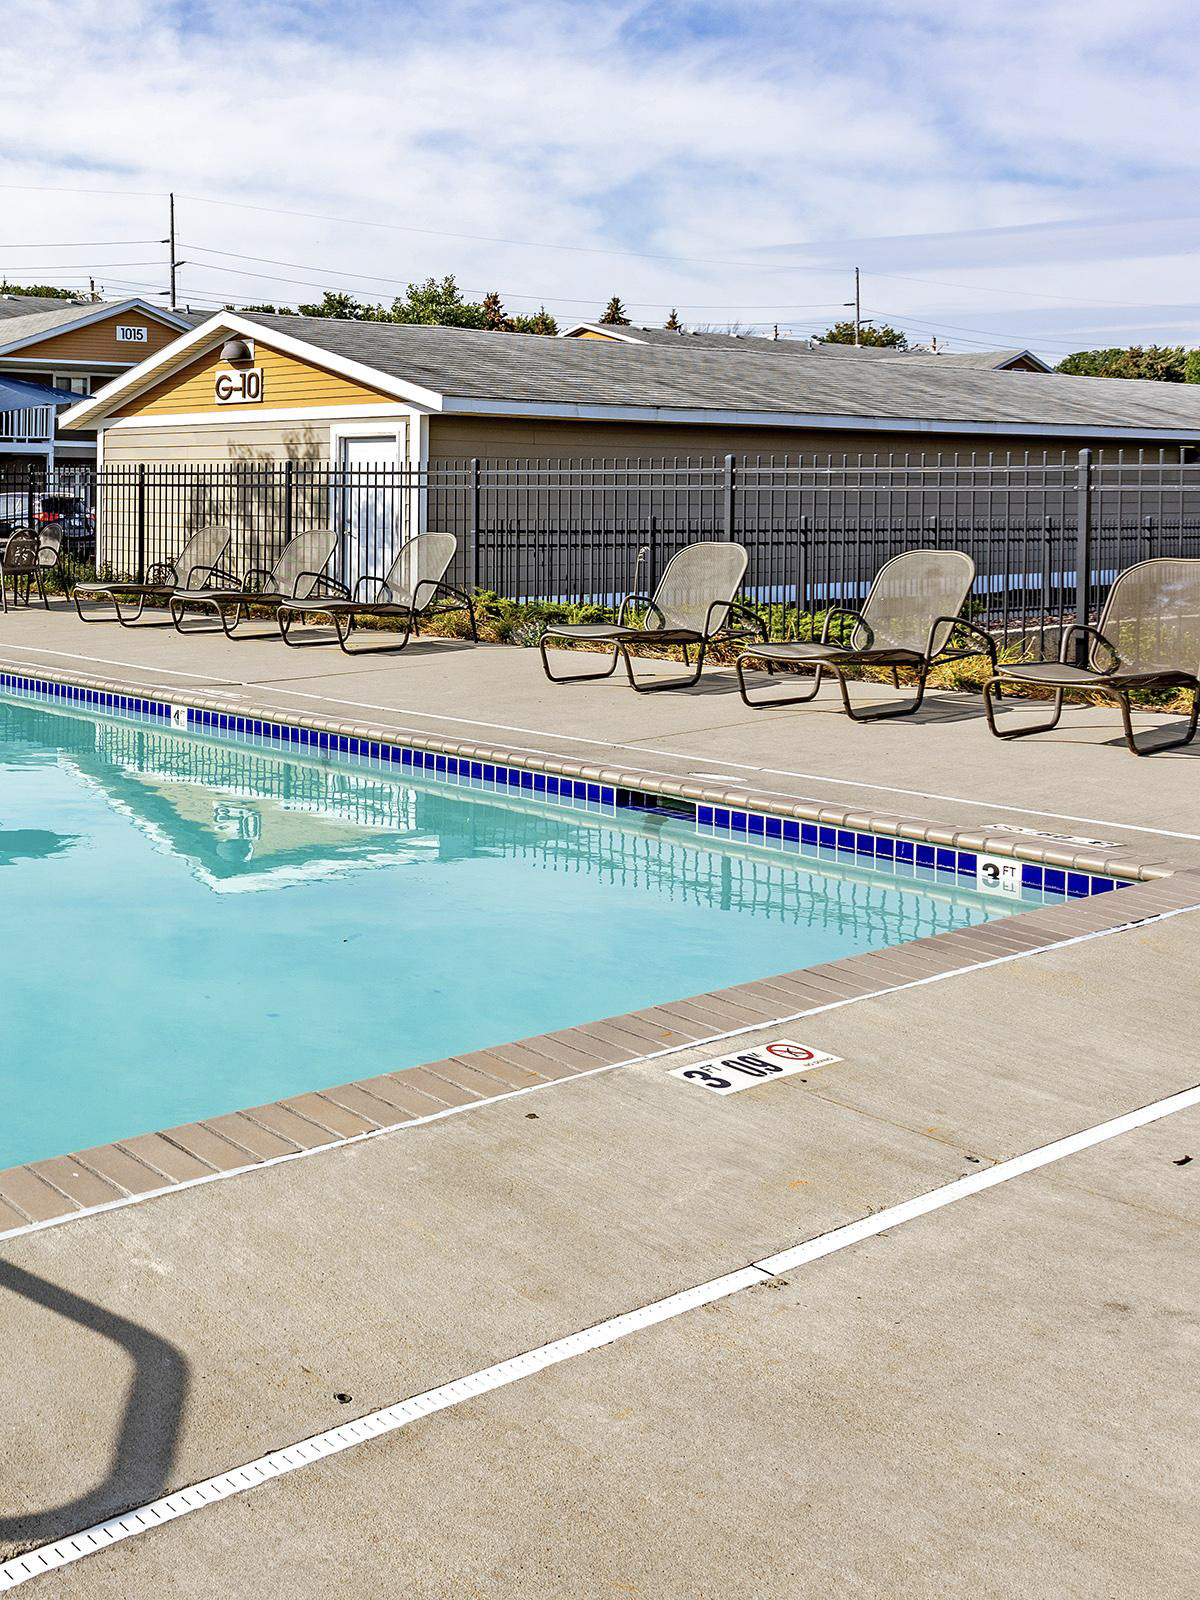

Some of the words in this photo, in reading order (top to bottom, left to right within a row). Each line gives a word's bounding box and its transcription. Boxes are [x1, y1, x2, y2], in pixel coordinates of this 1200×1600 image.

[120, 328, 144, 341] 1015
[215, 372, 260, 401] G-10
[982, 862, 1001, 881] 3
[1003, 865, 1017, 878] FT
[699, 1063, 722, 1074] FT
[720, 1055, 784, 1078] 0.9
[682, 1070, 732, 1089] 3
